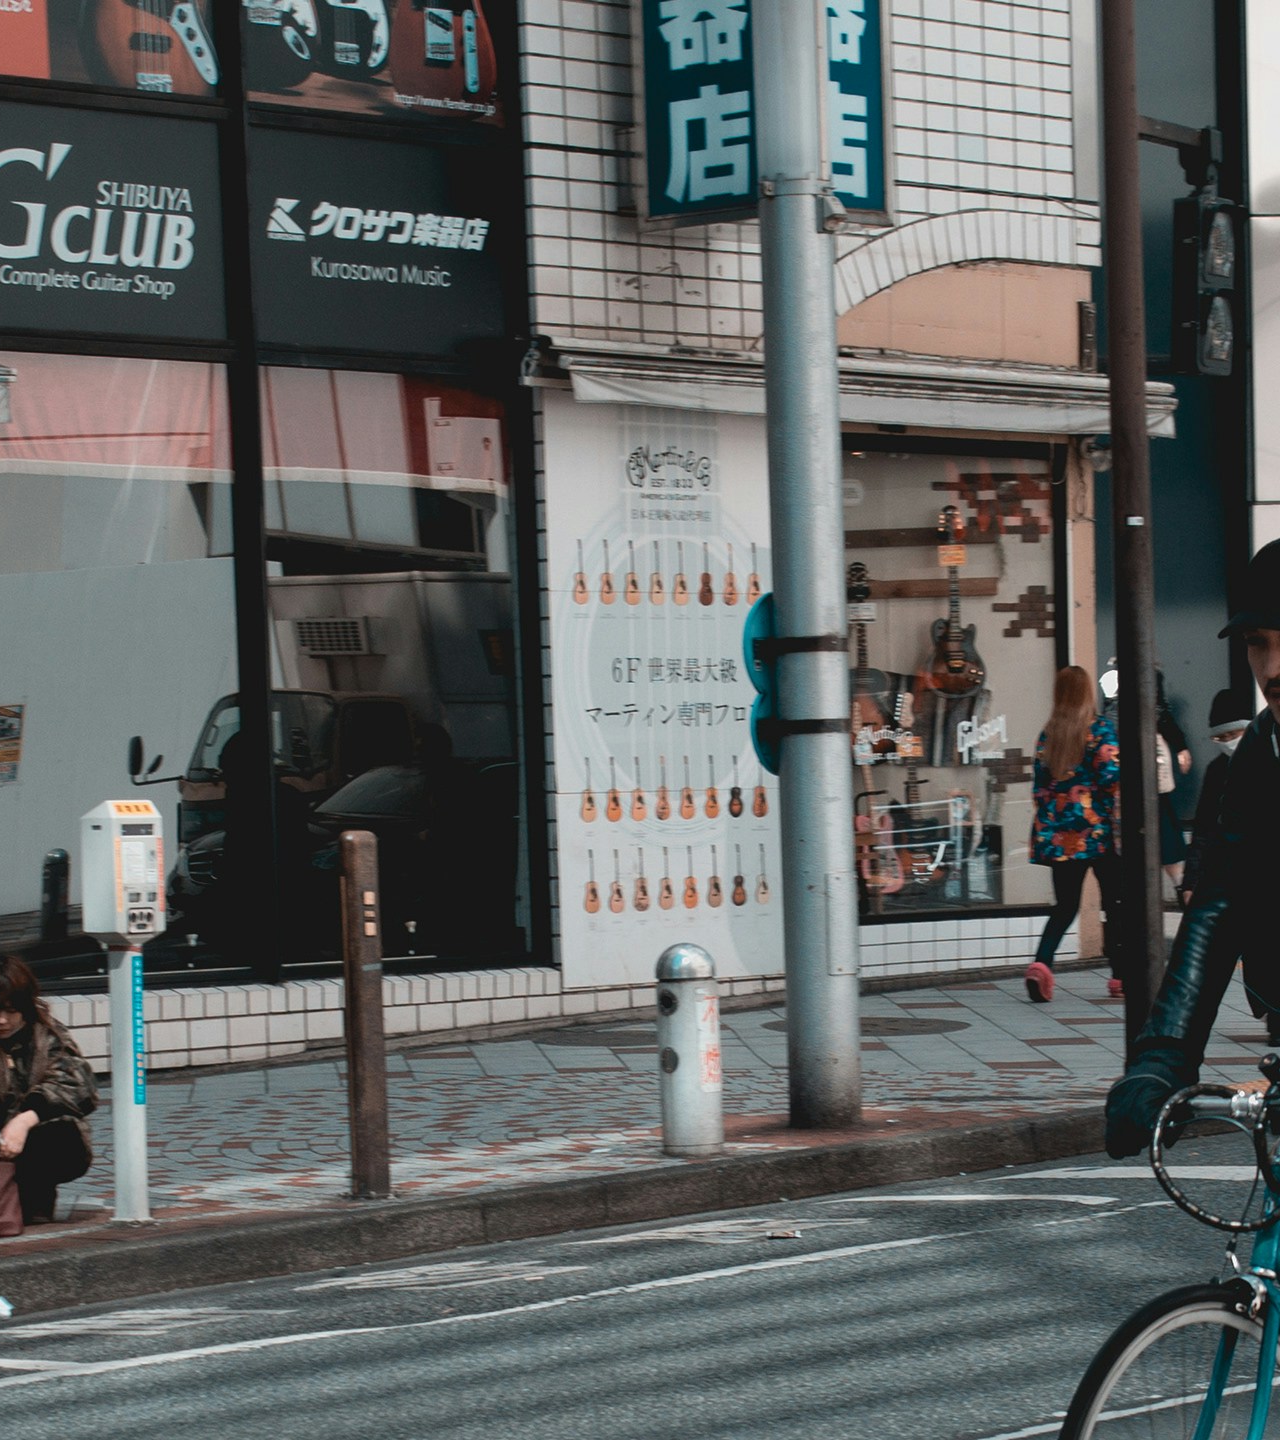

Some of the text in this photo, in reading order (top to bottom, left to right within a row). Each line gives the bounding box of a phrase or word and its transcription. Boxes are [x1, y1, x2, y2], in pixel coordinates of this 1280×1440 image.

[96, 180, 193, 214] SHIBUYA
[310, 200, 490, 252] クロサワ楽器店
[82, 270, 132, 296] Guitar
[133, 274, 175, 299] Shop
[311, 256, 452, 288] Kurosawa Music
[611, 657, 738, 683] 6F 世界最大級
[586, 700, 754, 728] マーティン専門フロ
